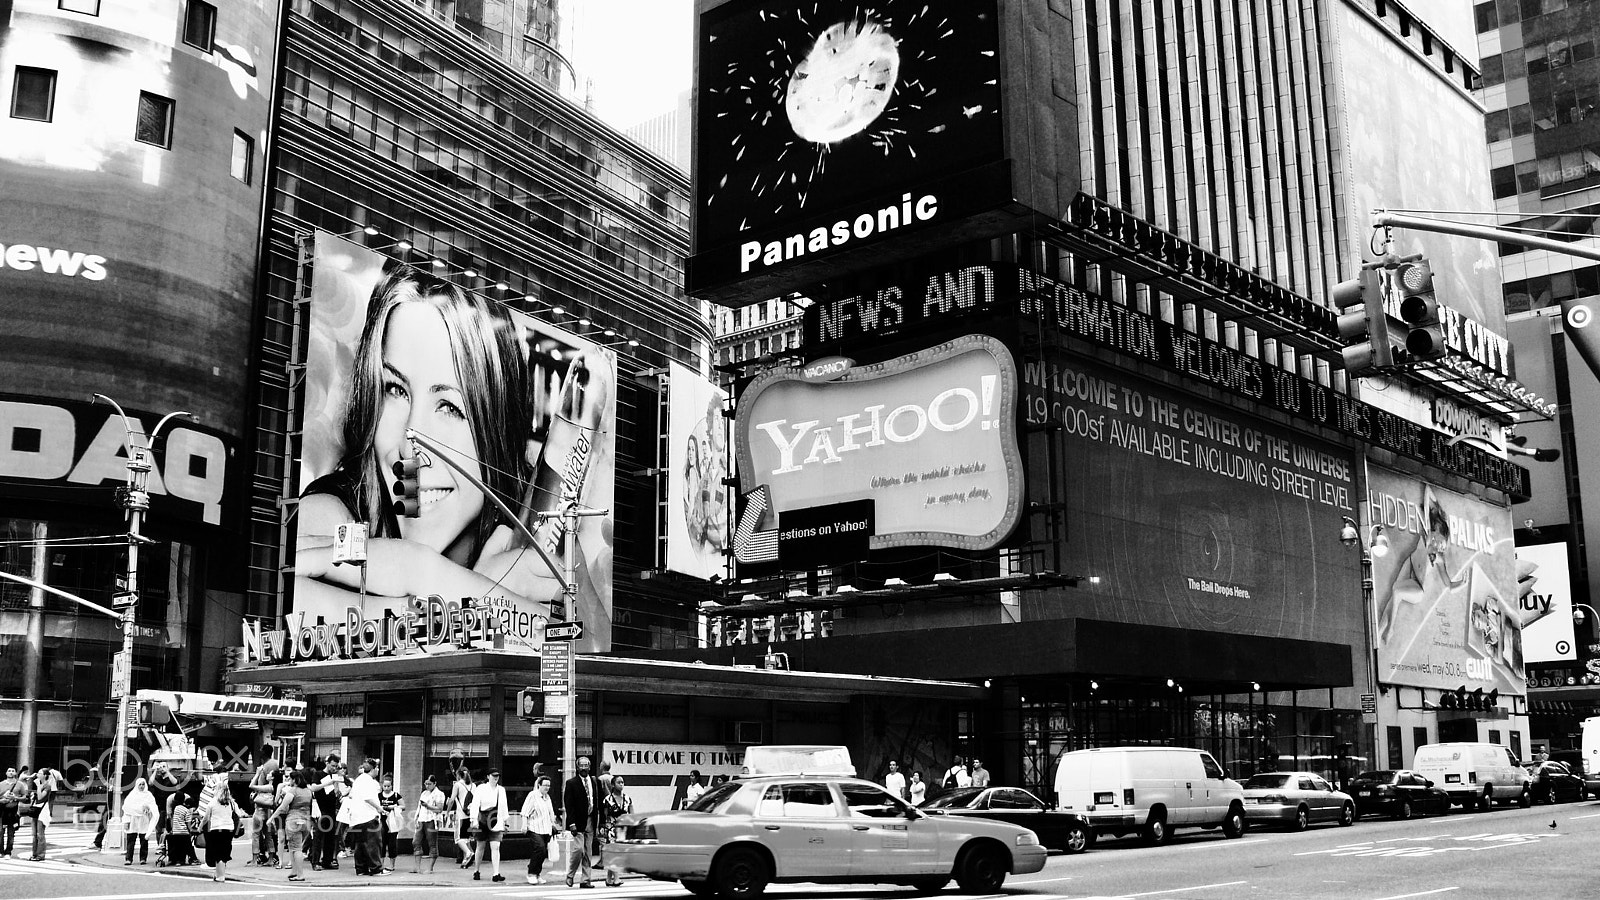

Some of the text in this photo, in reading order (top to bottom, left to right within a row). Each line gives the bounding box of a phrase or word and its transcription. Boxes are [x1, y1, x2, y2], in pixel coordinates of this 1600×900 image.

[740, 192, 938, 273] Panasonic
[0, 243, 107, 281] ews
[803, 359, 849, 379] VACANCY
[1308, 382, 1328, 423] TO
[1121, 386, 1144, 418] TO
[1148, 394, 1180, 430] THE
[1183, 407, 1241, 449] CENTER
[1244, 427, 1262, 454] OF
[1265, 434, 1291, 465] THE
[1292, 441, 1351, 483] UNIVERSE
[1109, 418, 1191, 466] AVAILABLE
[1195, 443, 1268, 488] INCLUDING
[1271, 466, 1316, 501] STREET
[1319, 480, 1353, 511] LEVEL
[780, 518, 869, 541] estions on Yahoo!
[1369, 489, 1430, 535] HIDDEN
[1449, 515, 1495, 556] PALMS
[1187, 577, 1200, 590] The
[1200, 579, 1214, 593] Ball
[1214, 582, 1234, 597] Drops
[242, 593, 490, 663] NEW YORK POLICE DEPT
[1567, 676, 1576, 685] S
[611, 749, 686, 766] WELCOME
[688, 750, 707, 766] TO
